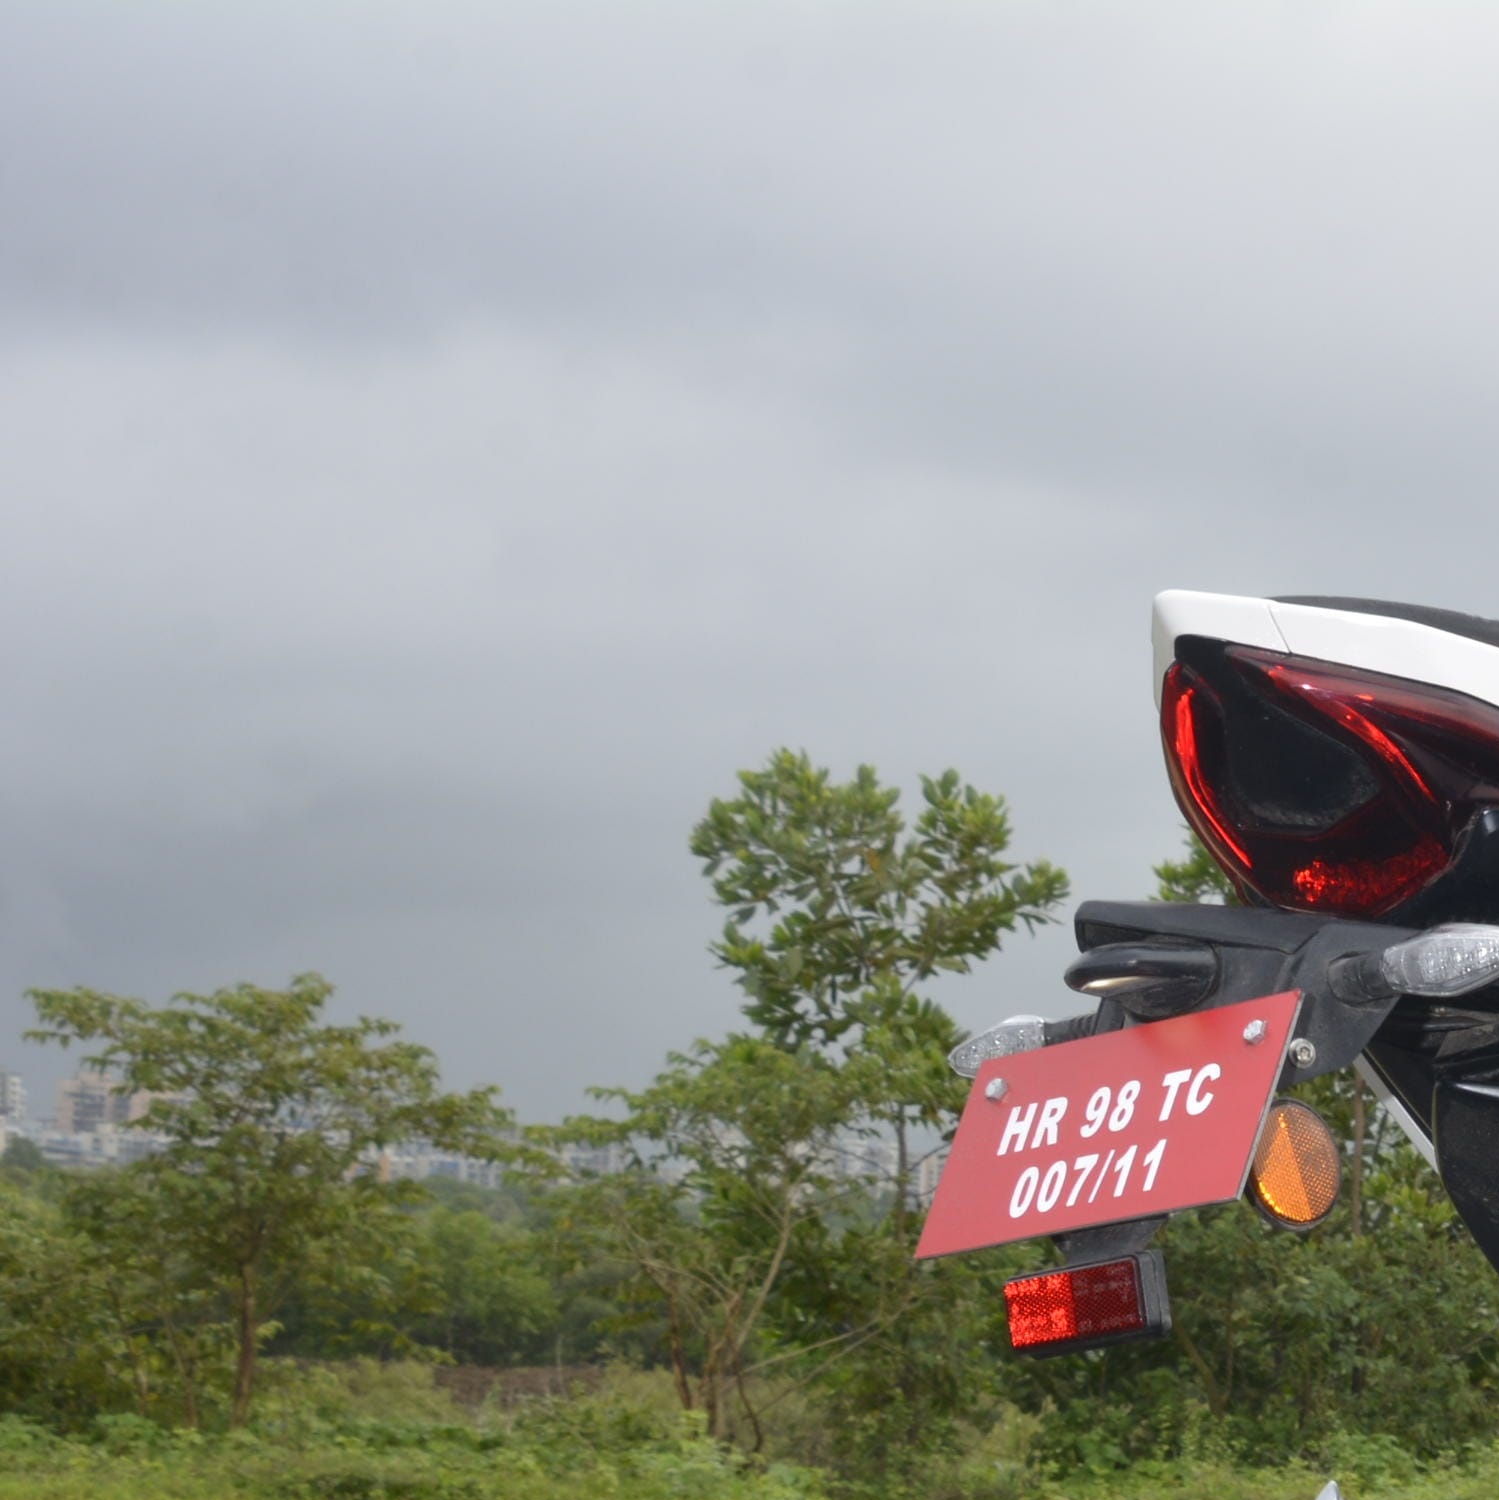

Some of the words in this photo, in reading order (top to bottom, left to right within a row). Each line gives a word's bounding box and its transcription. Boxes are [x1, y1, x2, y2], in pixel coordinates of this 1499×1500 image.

[996, 1096, 1069, 1156] HR
[1079, 1079, 1141, 1138] 98
[1158, 1062, 1222, 1122] TC
[1009, 1138, 1167, 1219] 007/11
